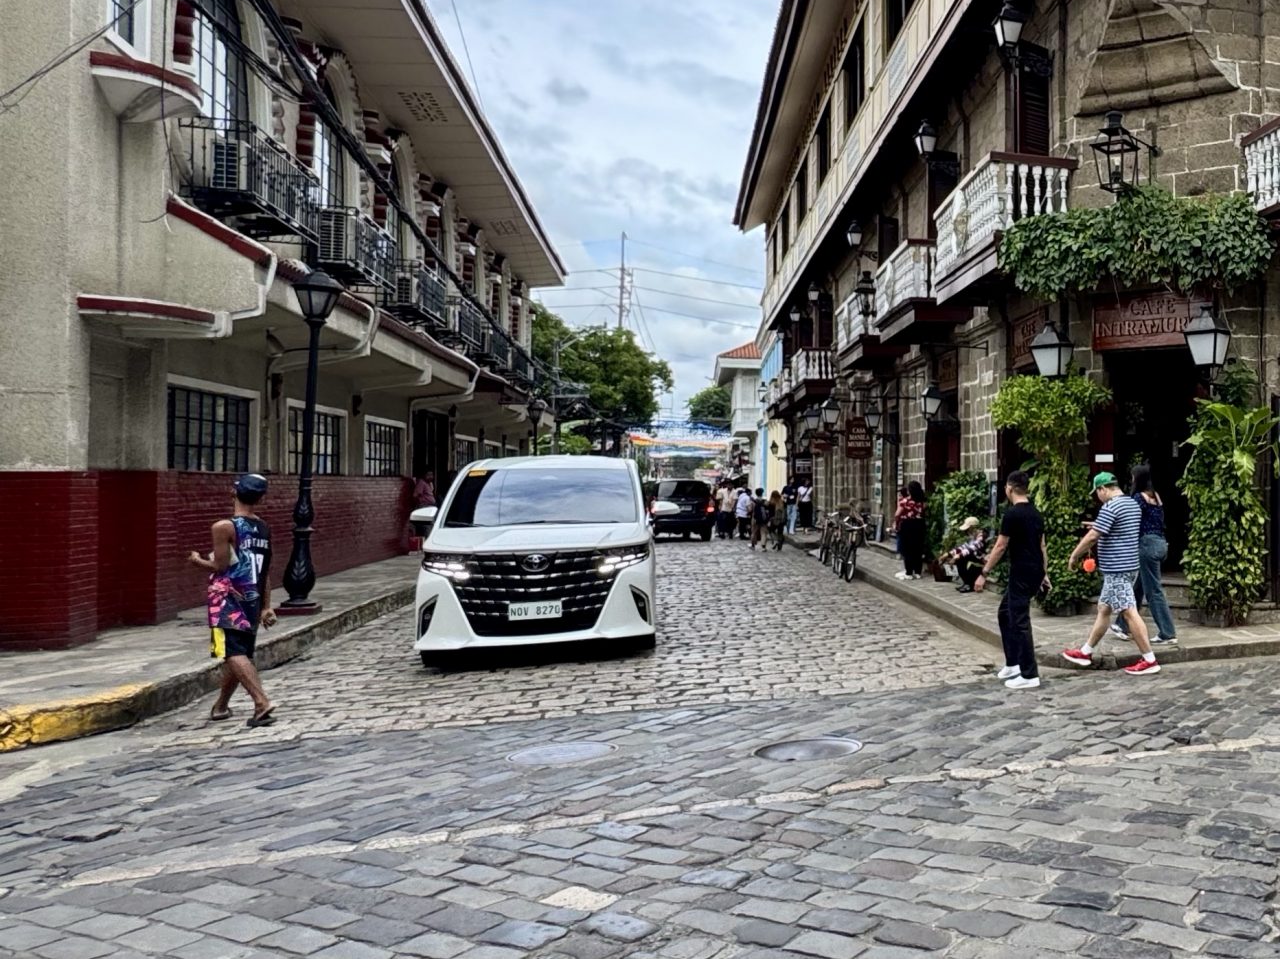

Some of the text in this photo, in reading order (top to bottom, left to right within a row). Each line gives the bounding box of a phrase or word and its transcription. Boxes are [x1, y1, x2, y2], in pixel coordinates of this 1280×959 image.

[1129, 297, 1177, 317] CAFE
[1095, 317, 1190, 338] INTRAMUR
[536, 605, 560, 615] 8270
